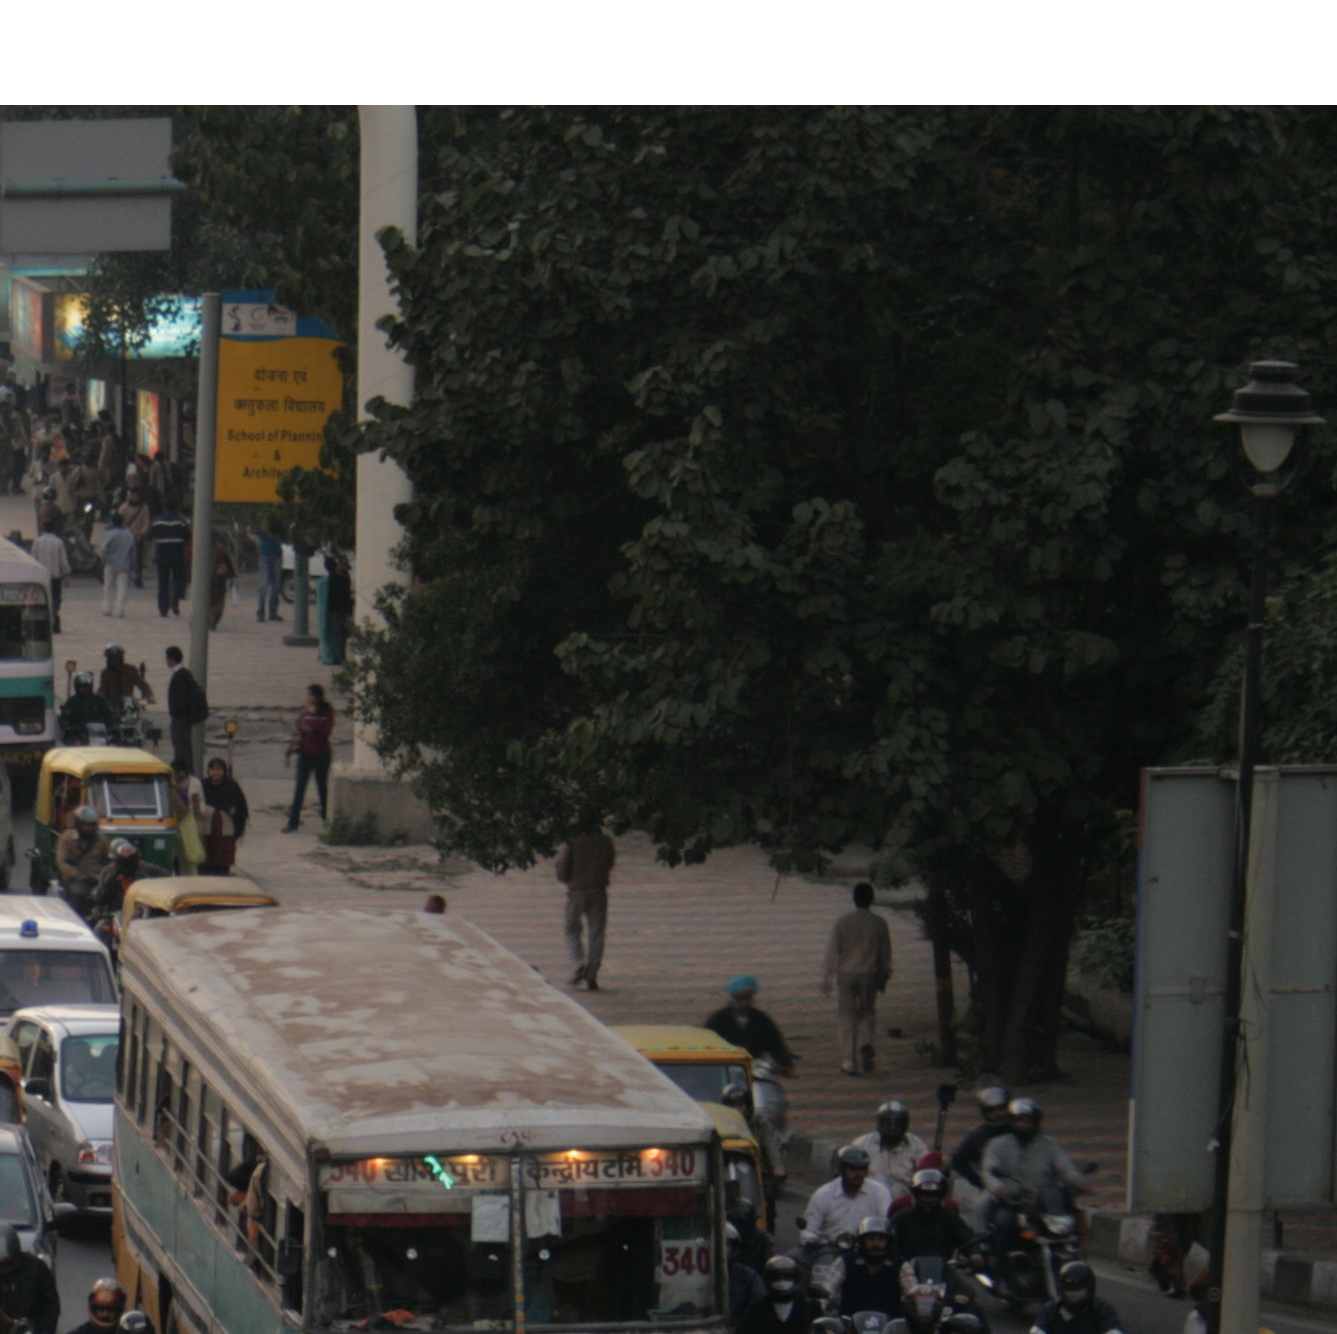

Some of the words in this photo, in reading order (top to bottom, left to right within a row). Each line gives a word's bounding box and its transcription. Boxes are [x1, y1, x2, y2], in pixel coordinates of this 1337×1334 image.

[227, 430, 265, 442] School
[267, 430, 279, 442] of
[280, 430, 324, 442] Plannin
[649, 1149, 696, 1177] 340
[662, 1246, 711, 1276] 340
